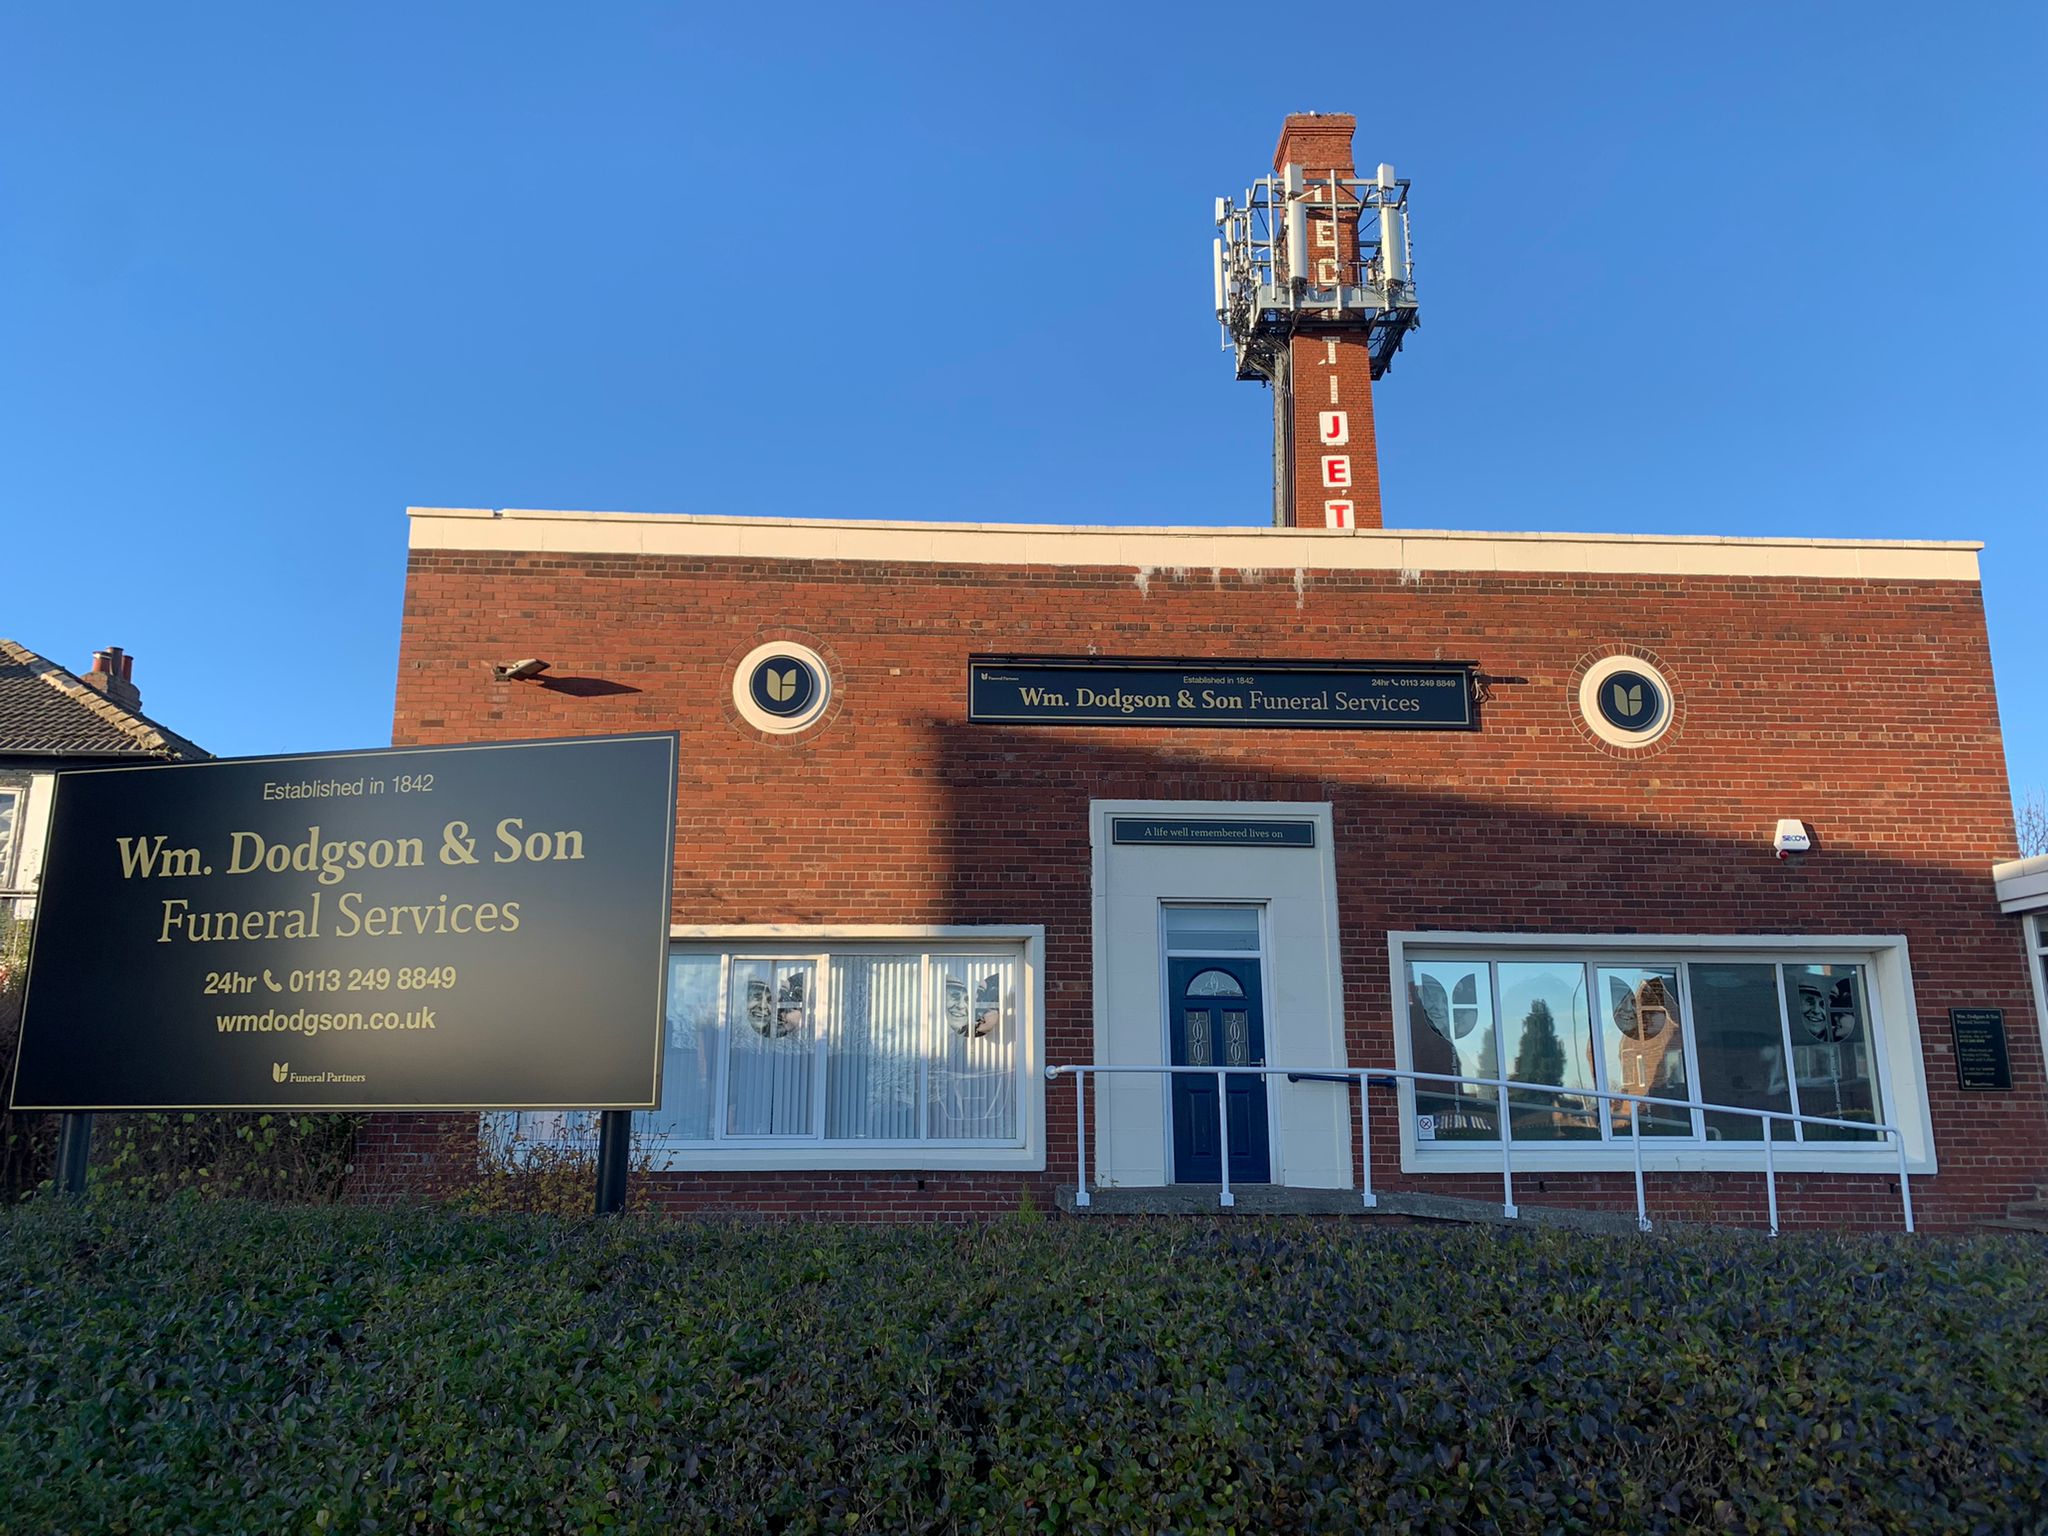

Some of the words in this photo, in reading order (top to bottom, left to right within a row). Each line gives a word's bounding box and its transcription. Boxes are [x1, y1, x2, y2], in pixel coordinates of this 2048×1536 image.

[1183, 676, 1225, 685] Established
[1227, 676, 1234, 685] in
[1236, 677, 1255, 685] 1842
[1371, 678, 1390, 687] 24hr
[1400, 679, 1418, 687] 0113
[1419, 680, 1434, 688] 249
[1436, 680, 1457, 688] 8849
[1018, 687, 1070, 707] Wm.
[1076, 688, 1171, 714] Dodgson
[1176, 690, 1196, 709] &
[1202, 690, 1243, 709] Son
[1249, 690, 1329, 711] Funeral
[1335, 691, 1421, 712] Services
[263, 777, 364, 800] Established
[369, 777, 385, 795] in
[391, 773, 435, 793] 1842
[1144, 827, 1152, 837] A
[1153, 827, 1169, 837] life
[1170, 827, 1189, 837] well
[1191, 828, 1248, 838] remembered
[1249, 829, 1270, 838] lives
[116, 835, 213, 879] Wm.
[226, 826, 425, 885] Dodgson
[439, 820, 480, 865] &
[494, 817, 585, 863] Son
[157, 892, 321, 943] Funeral
[336, 892, 520, 938] Services
[203, 971, 257, 995] 24hr
[289, 969, 341, 993] 0113
[347, 967, 391, 991] 249
[396, 966, 457, 990] 8849
[216, 1006, 437, 1036] wmdodgson.co.uk
[290, 1072, 325, 1083] Funeral
[327, 1072, 367, 1083] Partners
